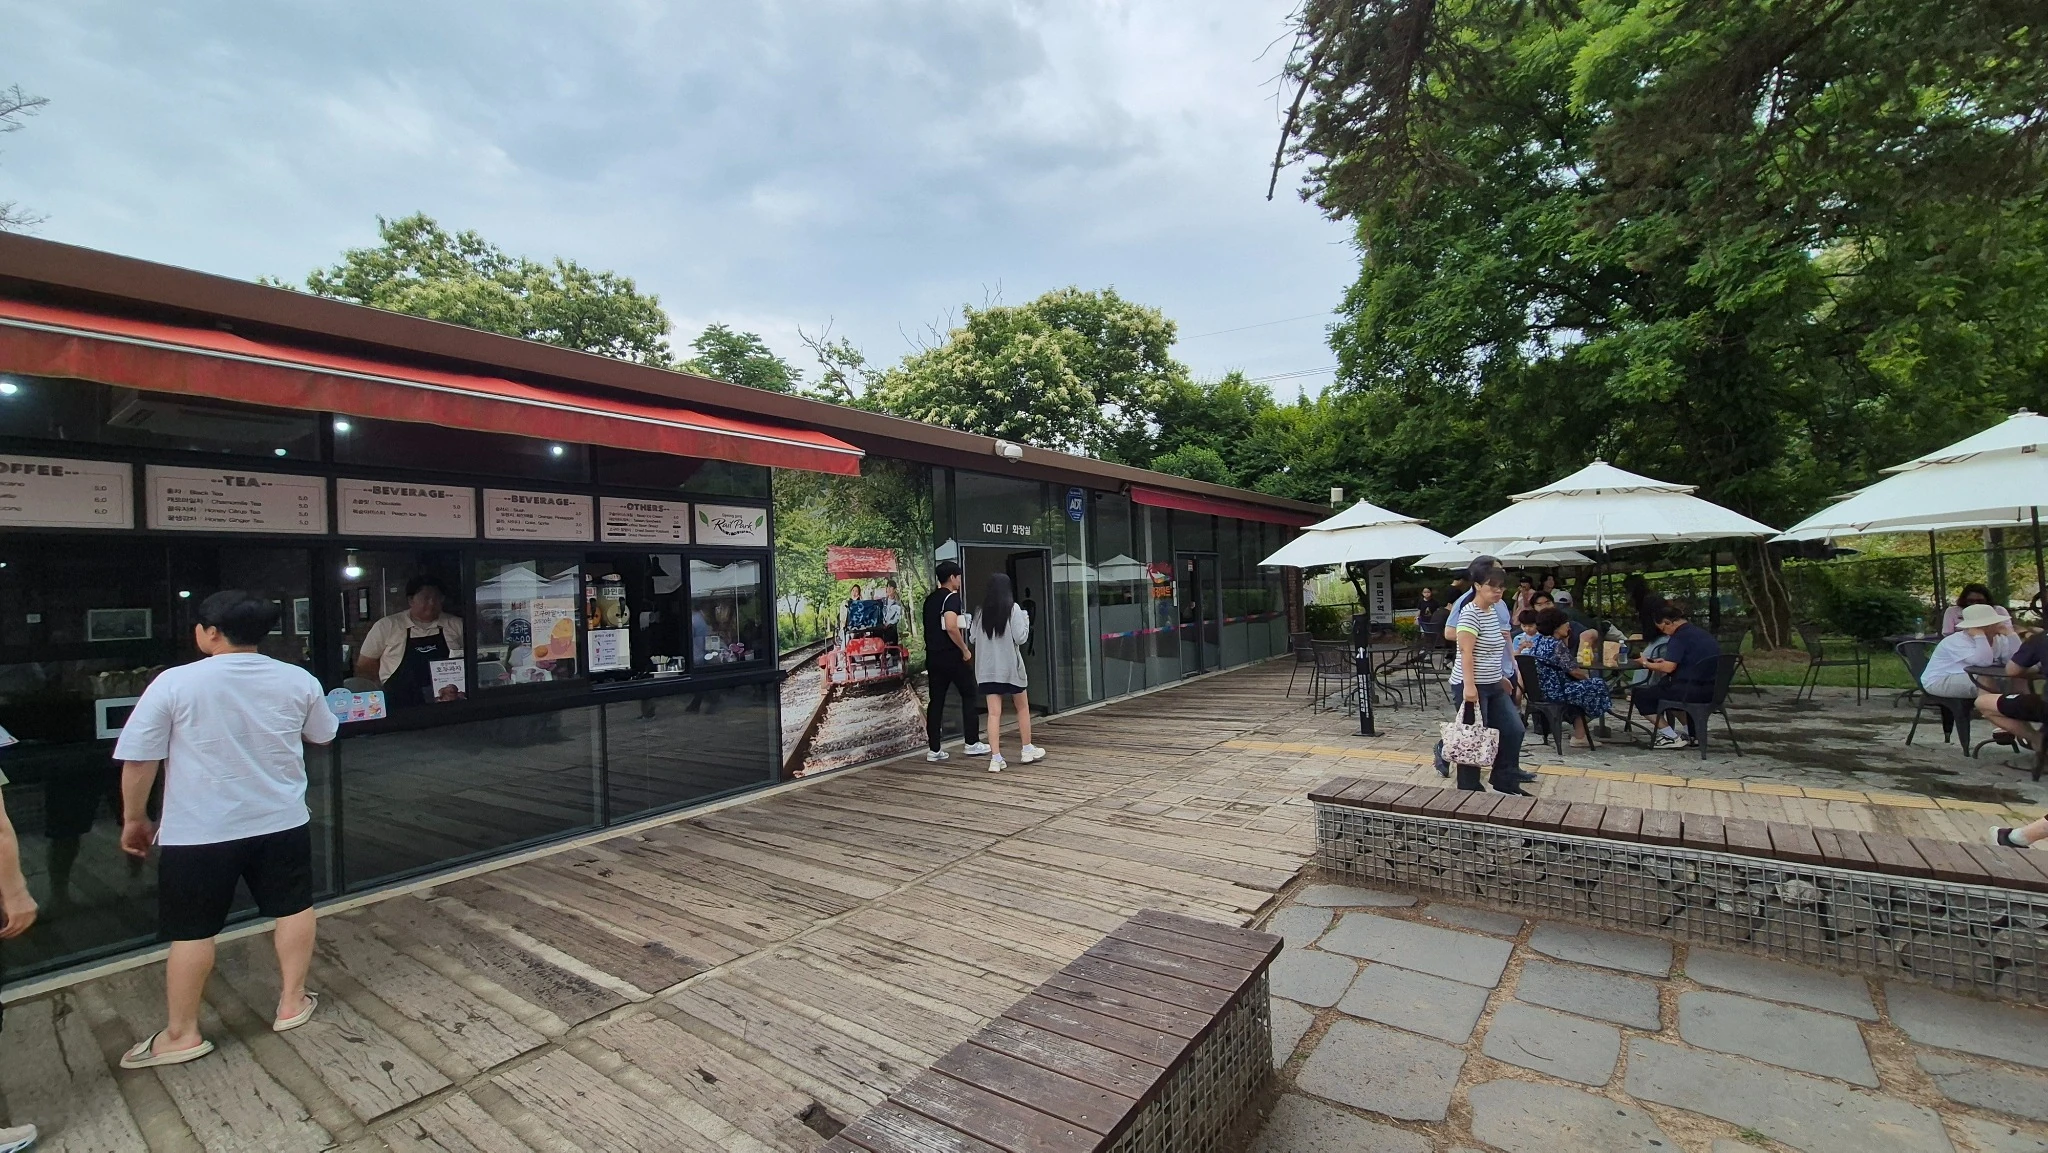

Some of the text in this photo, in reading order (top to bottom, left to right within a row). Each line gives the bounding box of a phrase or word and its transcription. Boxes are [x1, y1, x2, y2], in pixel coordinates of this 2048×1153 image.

[1069, 498, 1082, 511] ADT
[734, 519, 753, 531] Park
[982, 522, 1002, 534] TOILET
[1012, 524, 1031, 536] 화장실
